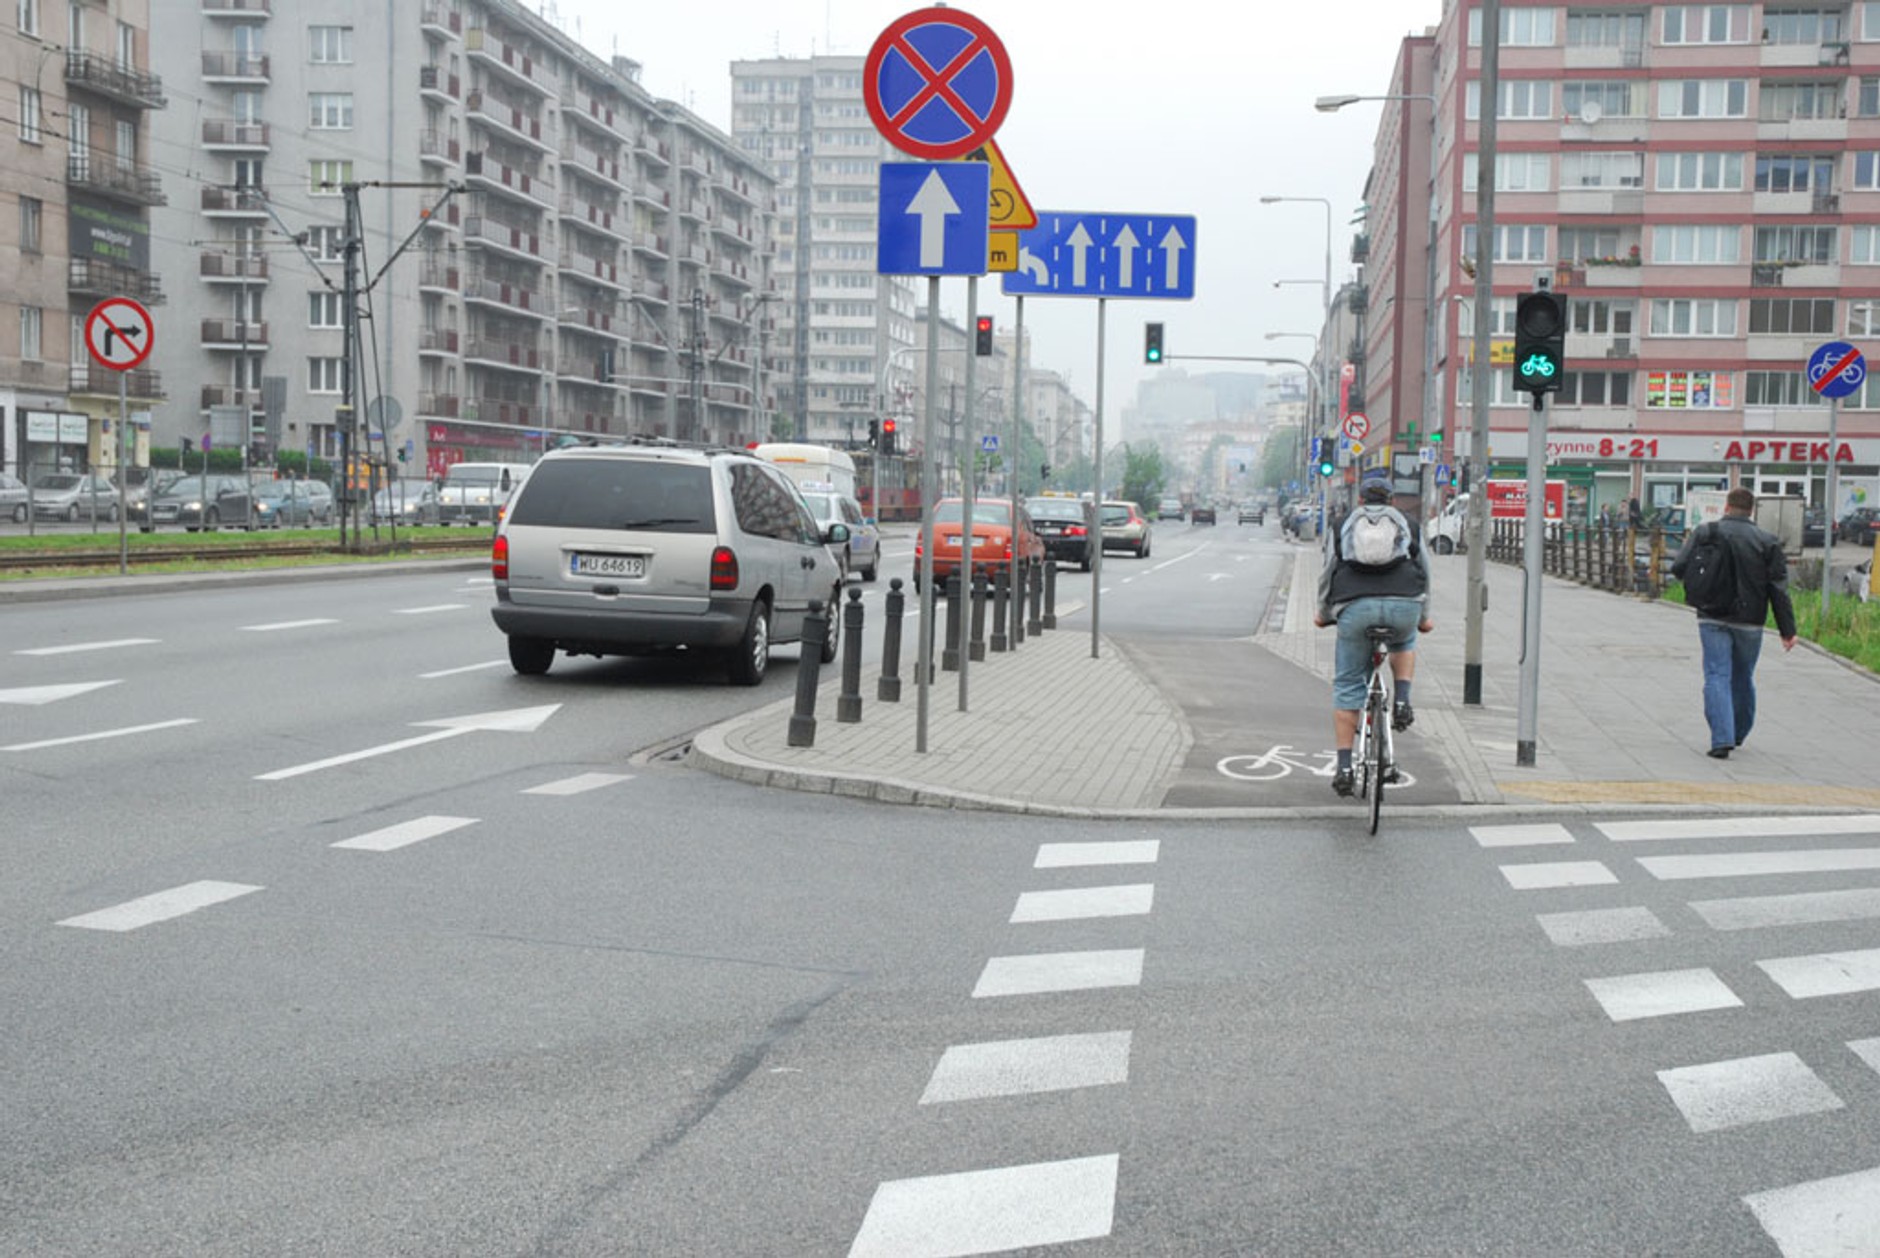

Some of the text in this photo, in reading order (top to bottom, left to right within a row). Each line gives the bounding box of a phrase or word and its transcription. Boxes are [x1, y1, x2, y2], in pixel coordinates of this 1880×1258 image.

[991, 250, 1007, 263] m
[1545, 442, 1595, 456] zynne
[1724, 441, 1854, 462] APTEKA
[601, 559, 642, 573] 64619
